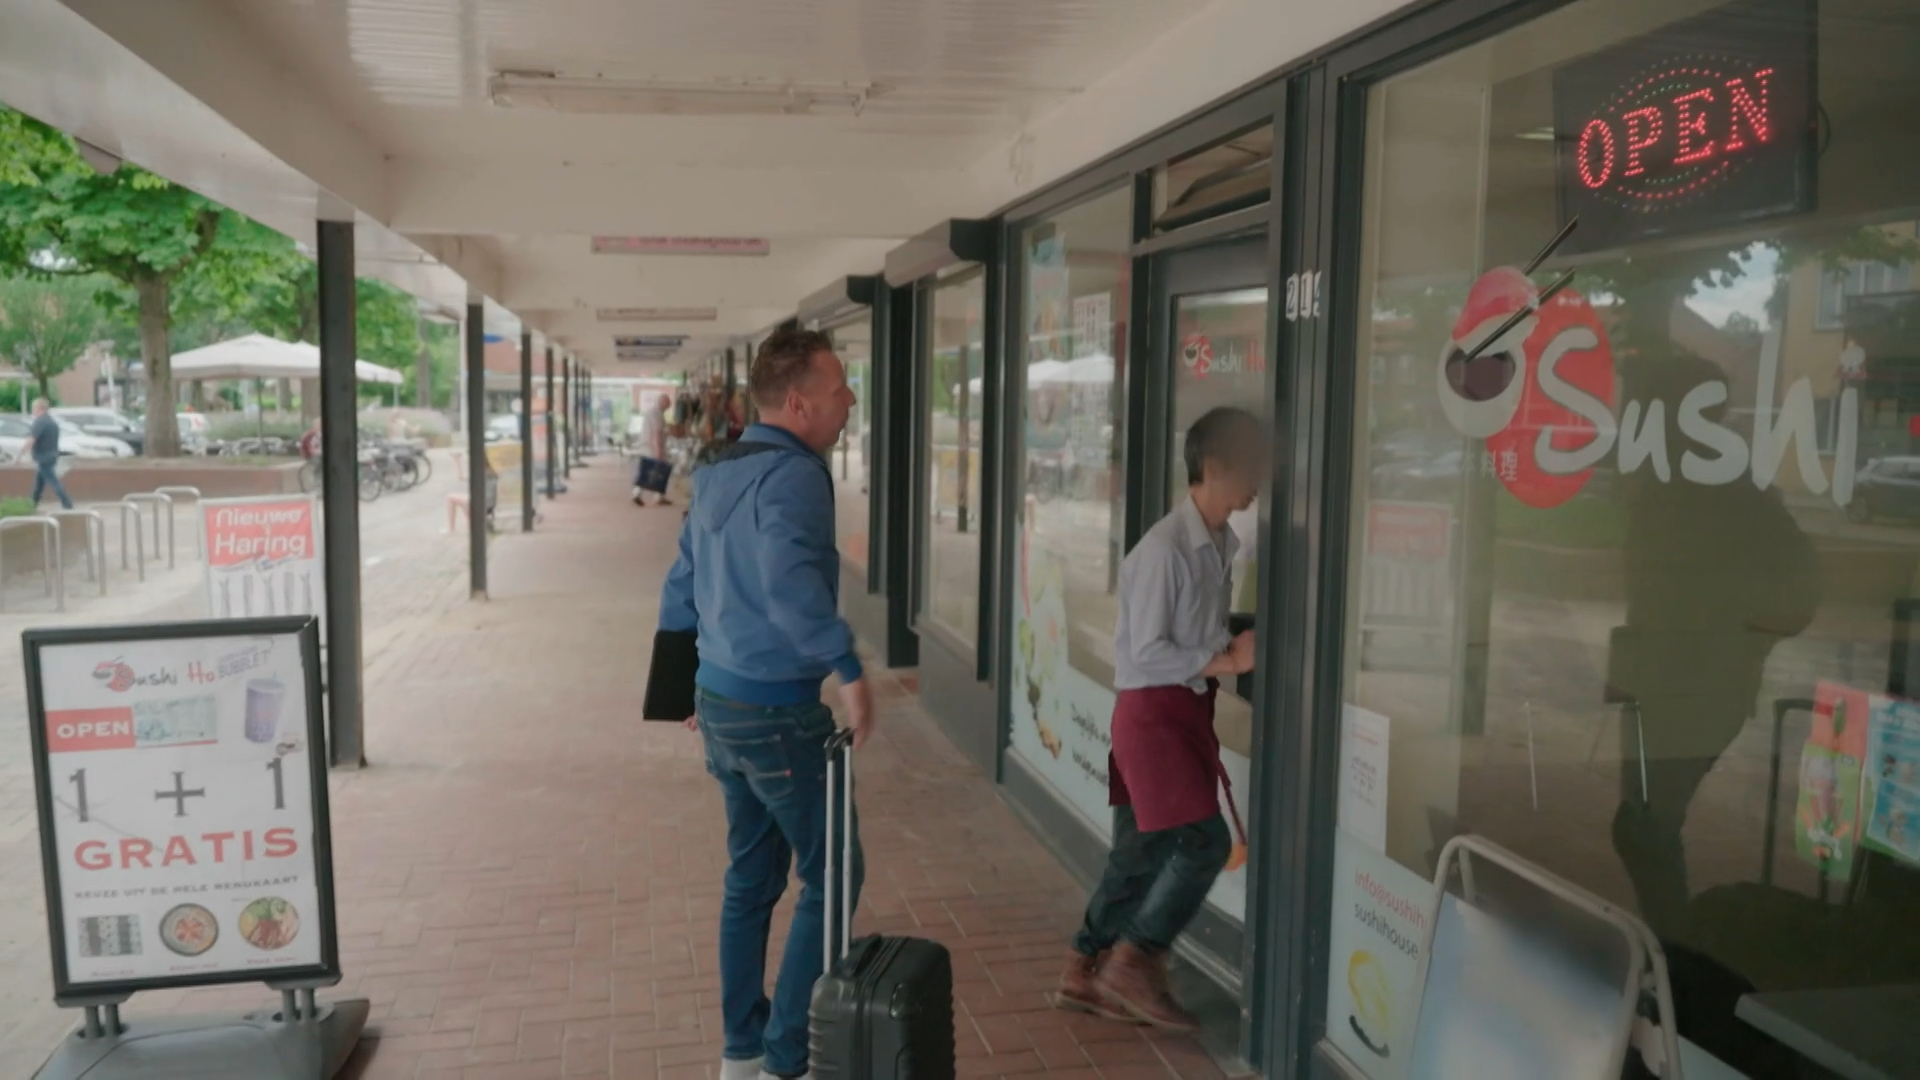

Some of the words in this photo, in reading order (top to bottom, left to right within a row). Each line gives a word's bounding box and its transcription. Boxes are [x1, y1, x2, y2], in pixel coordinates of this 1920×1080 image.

[1577, 67, 1774, 189] OPEN
[1534, 327, 1862, 507] Sushi
[214, 532, 306, 557] Haring
[215, 507, 303, 527] Nieuwe
[57, 720, 130, 739] OPEN
[69, 768, 90, 823] 1
[266, 757, 285, 810] 1
[74, 827, 298, 871] GRATIS
[1355, 867, 1428, 930] info@sushih
[1354, 902, 1419, 961] sushihouse
